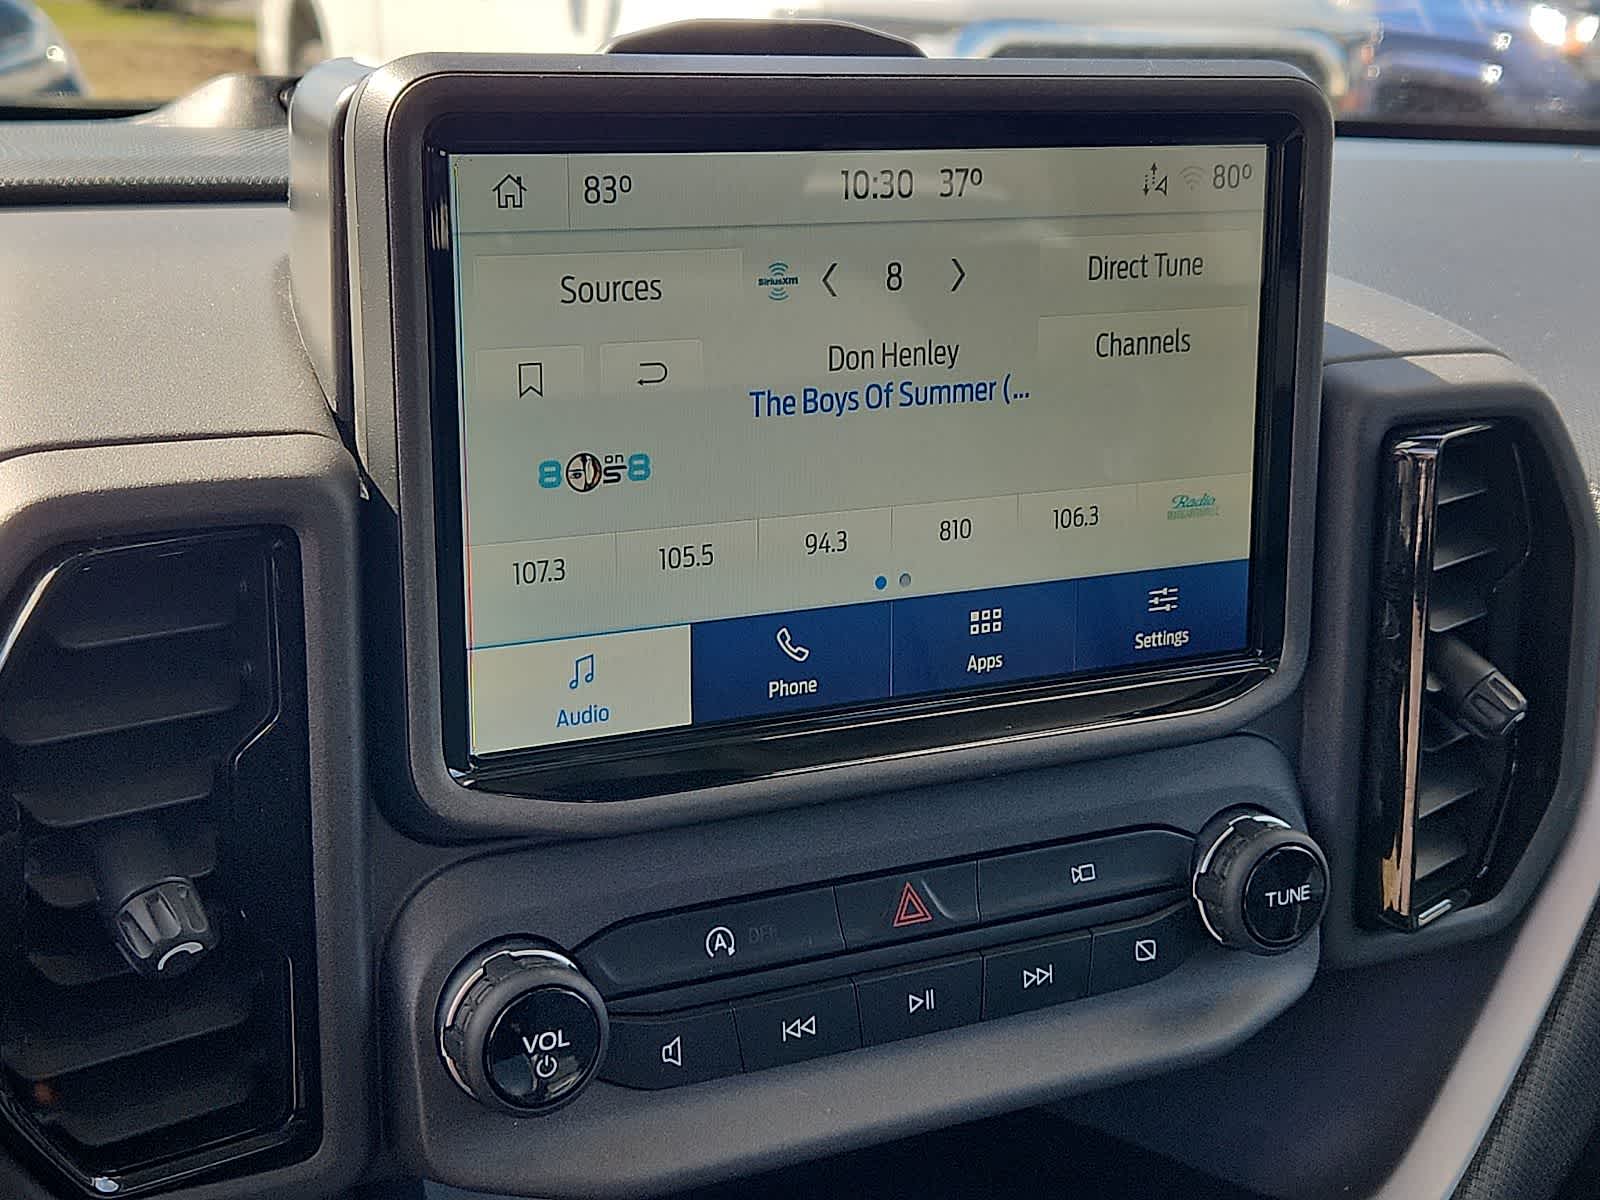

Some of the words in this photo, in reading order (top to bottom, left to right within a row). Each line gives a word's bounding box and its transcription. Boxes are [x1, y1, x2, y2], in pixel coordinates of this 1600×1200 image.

[840, 169, 914, 201] 10:30
[886, 262, 903, 291] 8
[1088, 253, 1149, 281] Direct
[1154, 251, 1204, 278] Tune
[560, 275, 663, 303] Sources
[828, 345, 874, 371] Don
[881, 339, 960, 369] Henley
[1095, 328, 1191, 358] Channels
[749, 389, 796, 417] The
[802, 387, 859, 416] Boys
[865, 381, 894, 409] Of
[899, 380, 997, 407] Summer
[1171, 491, 1217, 510] Radio
[939, 518, 972, 541] 810
[1052, 505, 1100, 530] 106.3
[805, 530, 848, 555] 94.3
[658, 544, 714, 570] 105.5
[512, 559, 566, 585] 107.3
[1134, 629, 1190, 650] Settings
[967, 654, 1004, 675] Apps
[768, 677, 818, 698] Phone
[556, 704, 610, 728] Audio
[1264, 884, 1311, 908] TUNE
[522, 1029, 571, 1053] VOL
